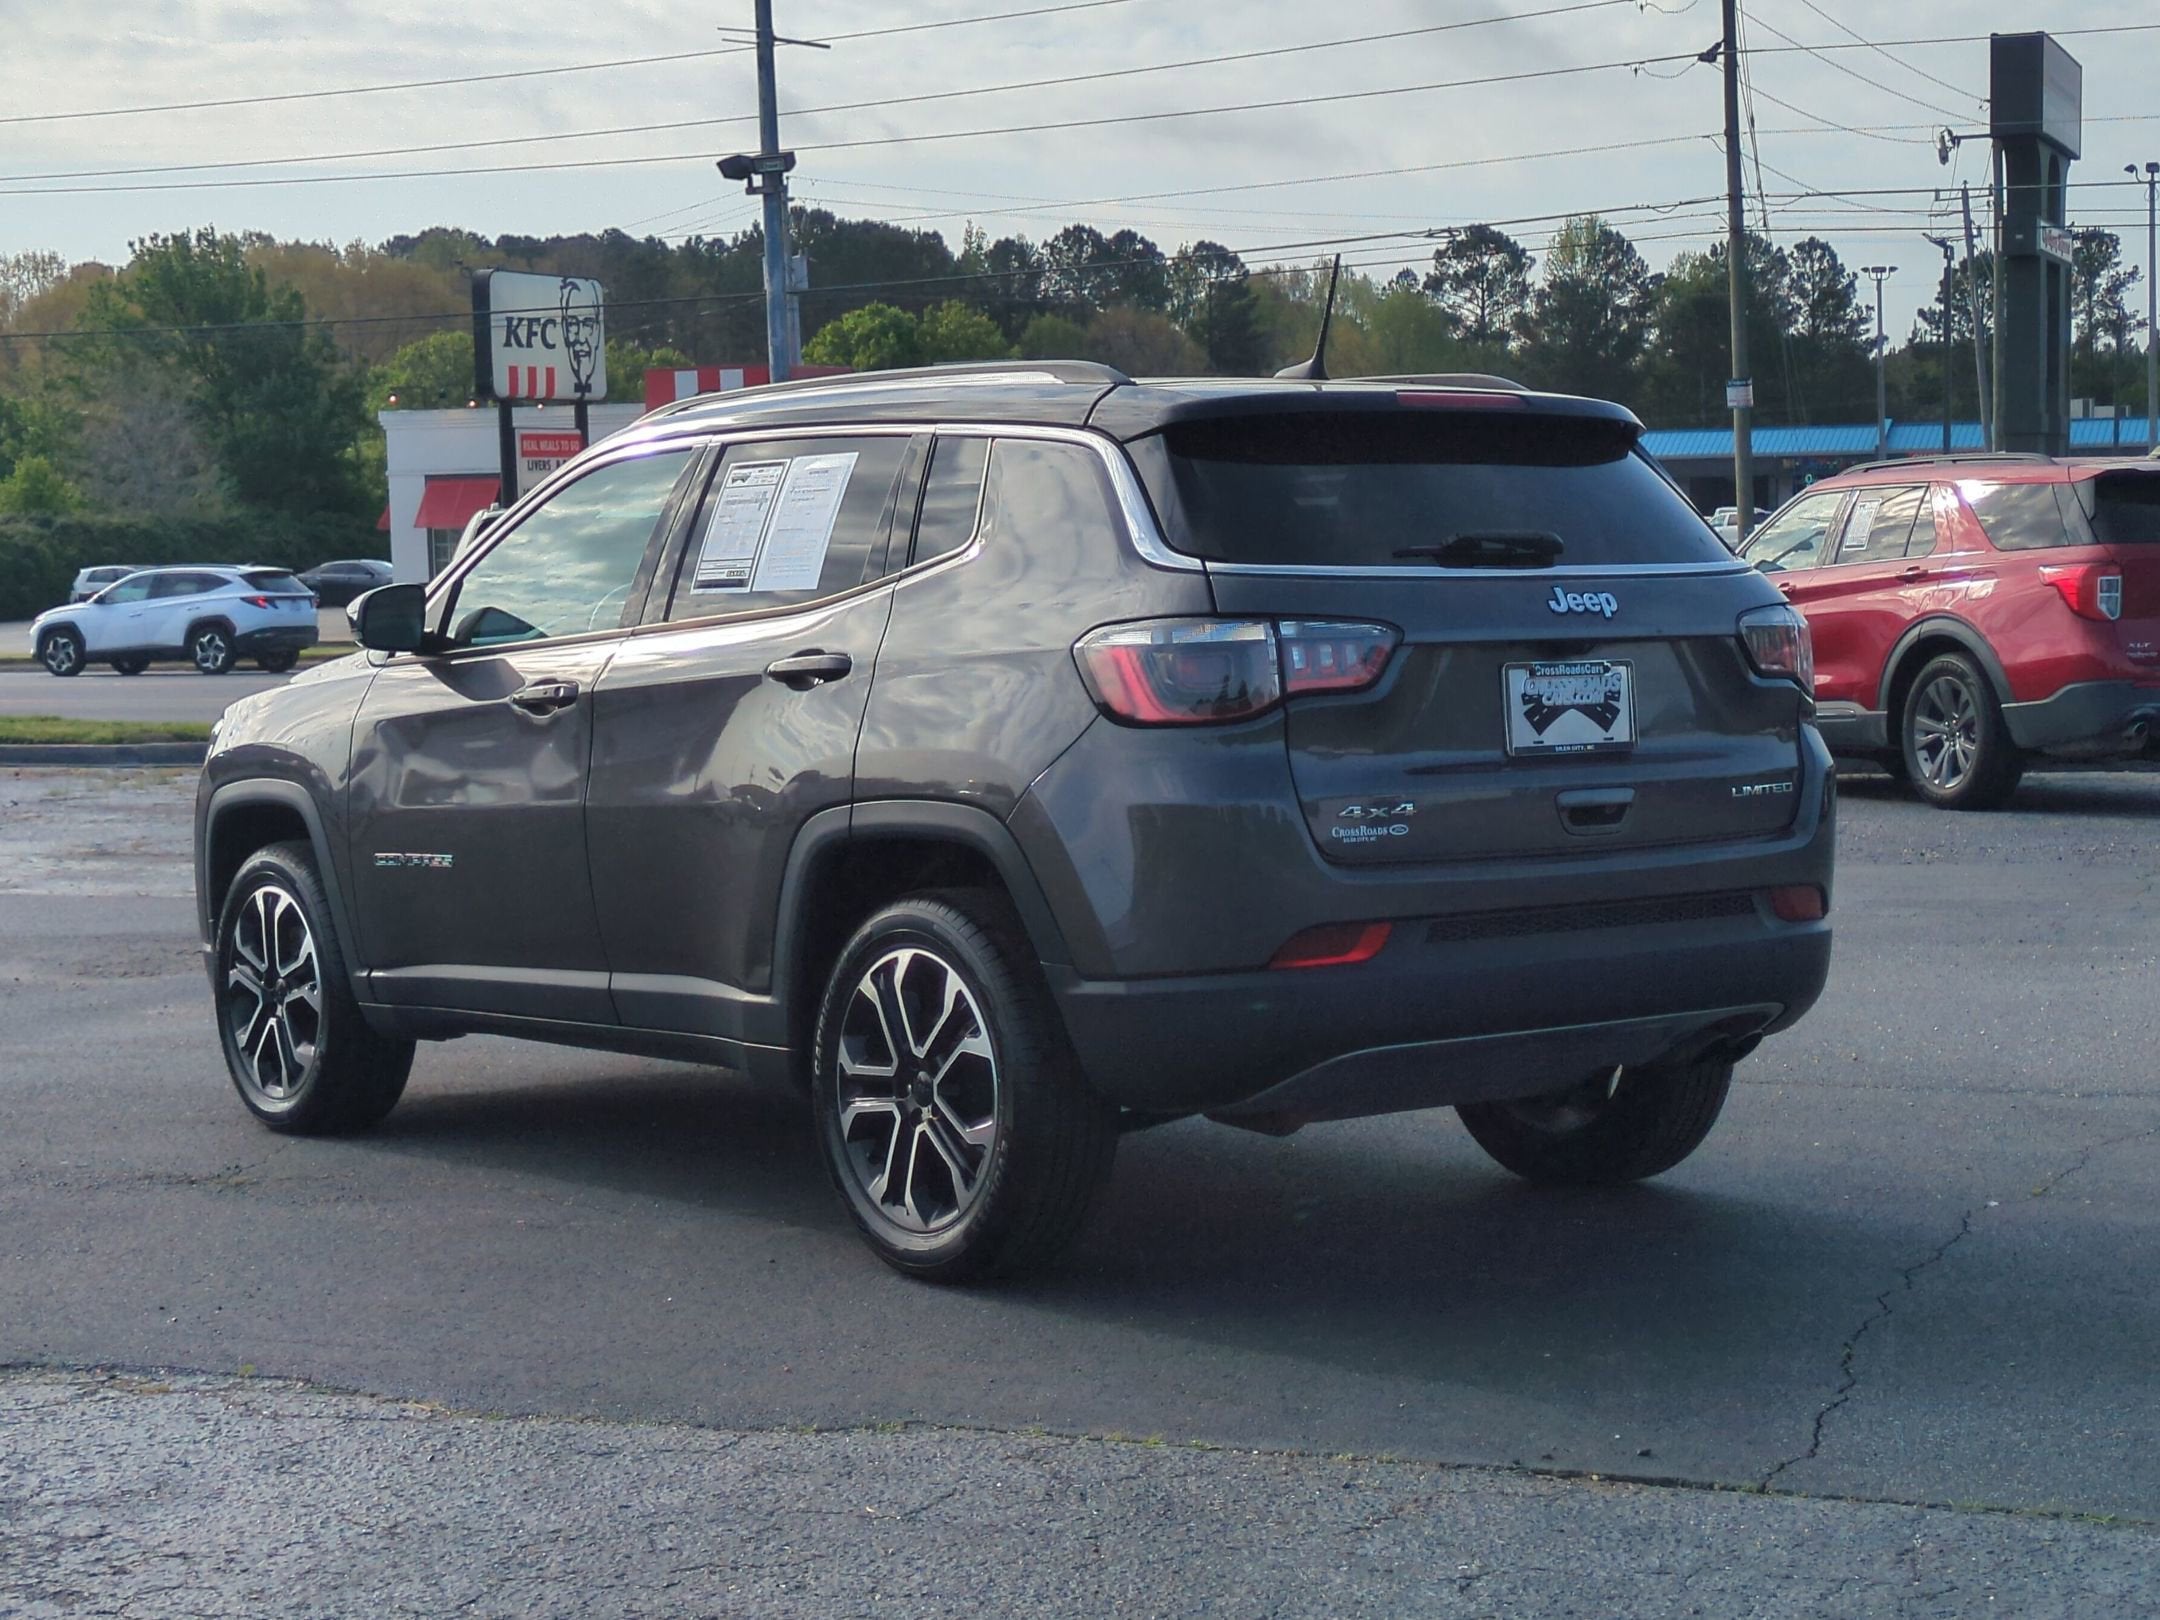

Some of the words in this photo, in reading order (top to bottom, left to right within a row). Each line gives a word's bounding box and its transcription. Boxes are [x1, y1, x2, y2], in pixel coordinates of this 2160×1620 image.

[503, 316, 557, 350] KFC
[527, 459, 551, 472] LIVERS
[1548, 585, 1618, 619] Jeep
[1731, 782, 1793, 798] LIMITED
